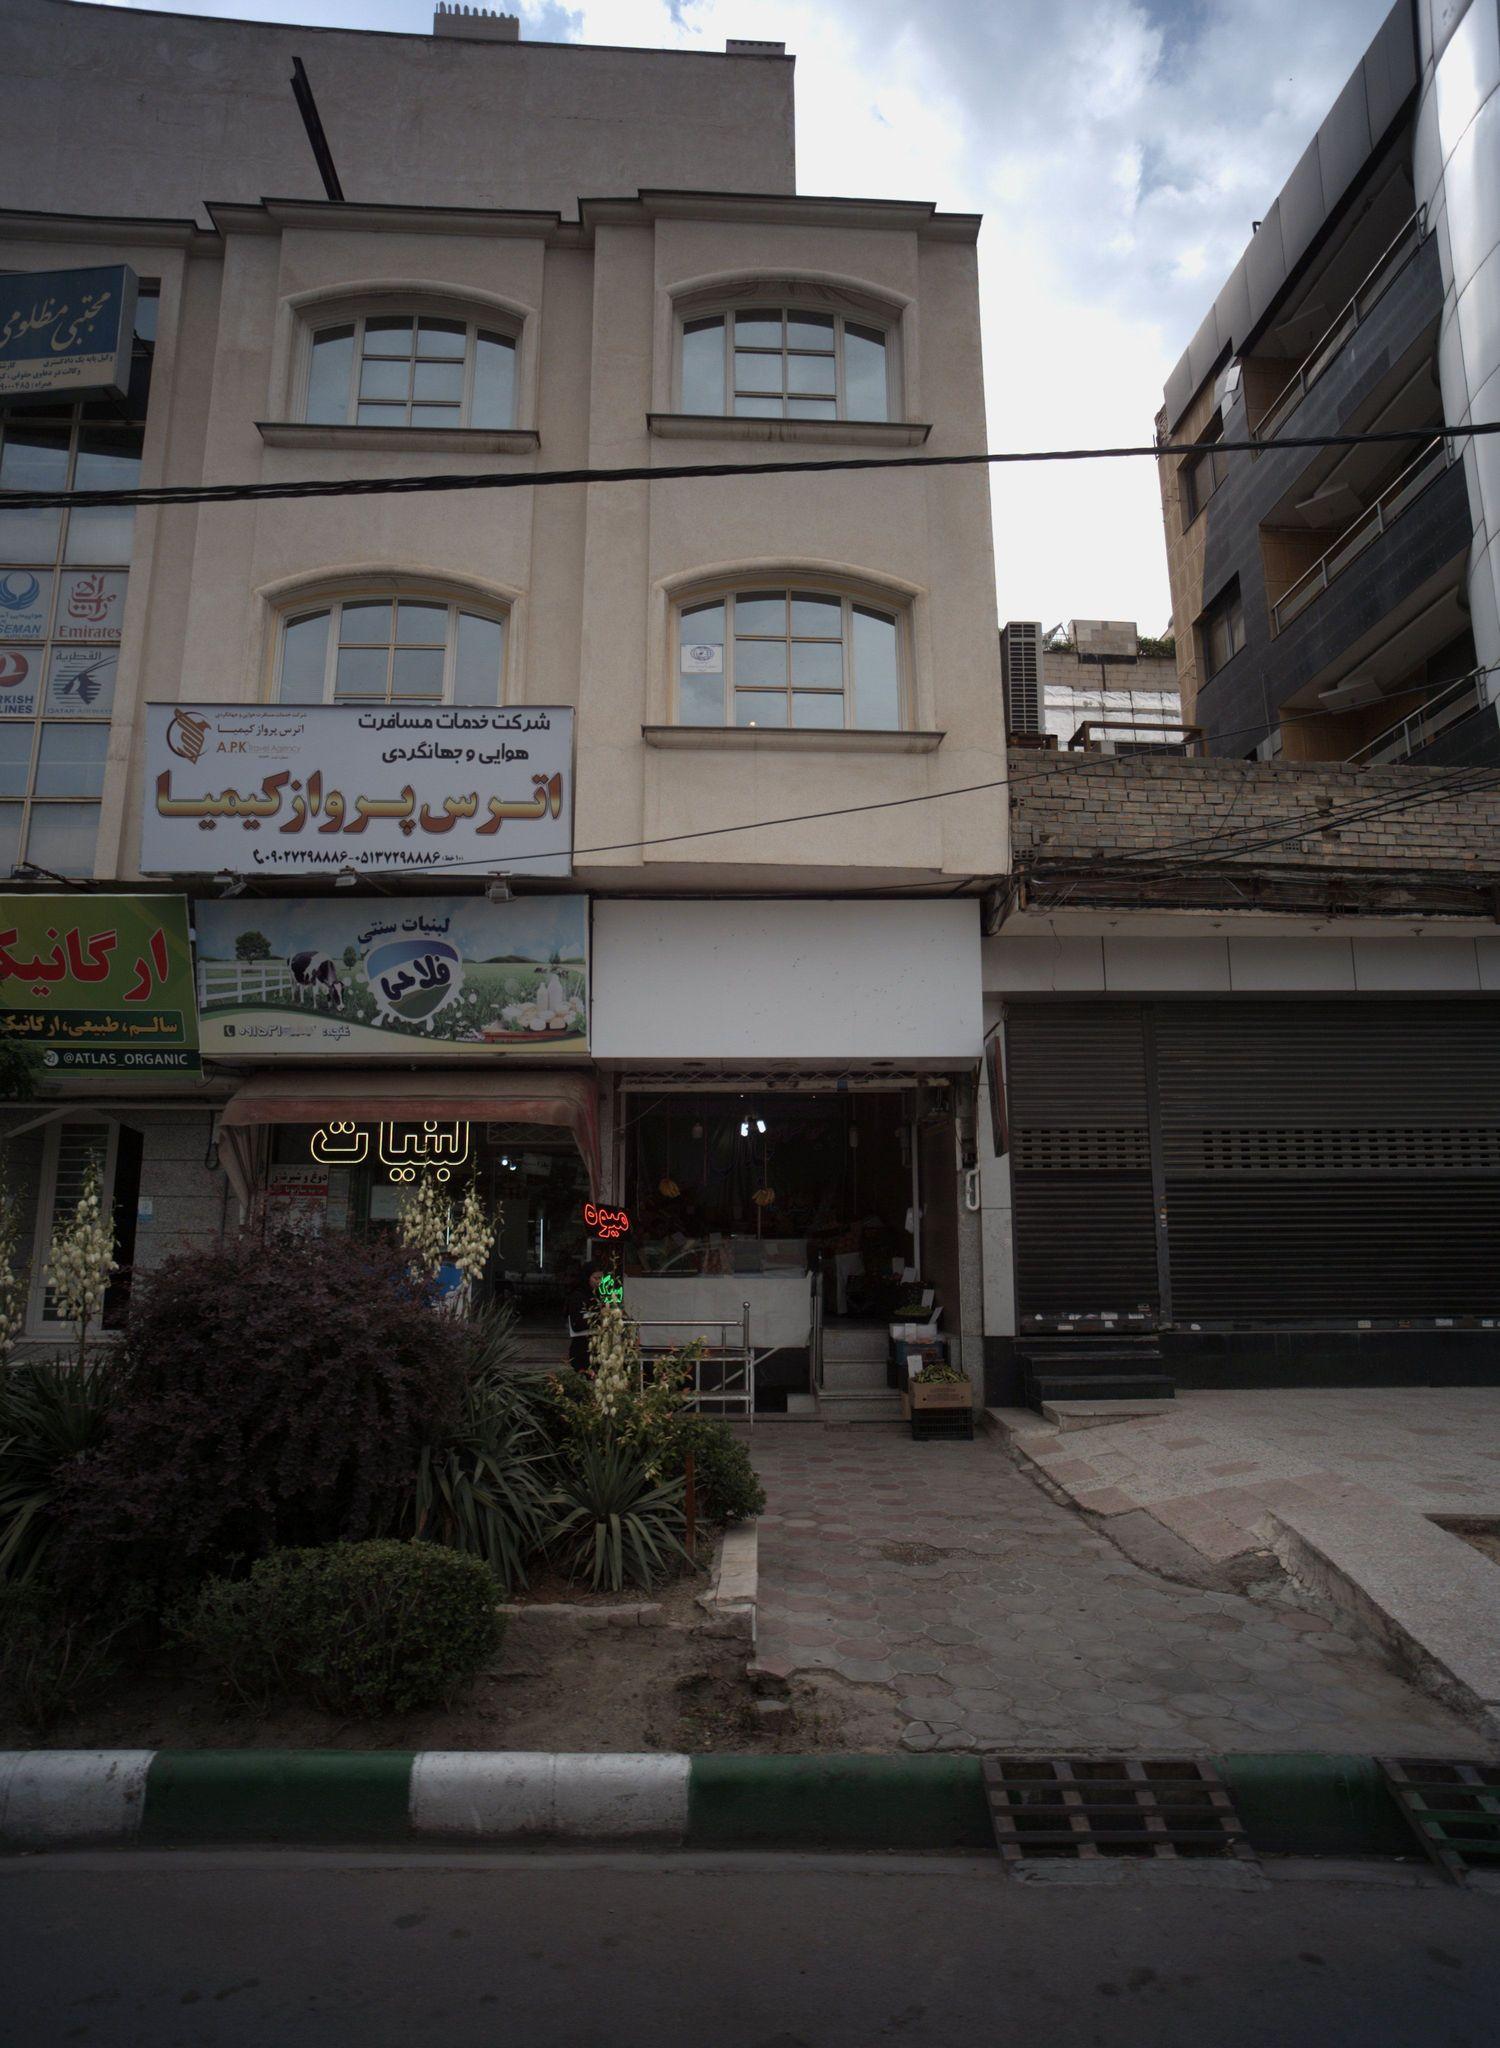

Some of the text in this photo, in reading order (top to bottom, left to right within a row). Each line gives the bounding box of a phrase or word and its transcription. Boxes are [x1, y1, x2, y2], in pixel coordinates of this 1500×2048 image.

[51, 292, 111, 351] مجتبی
[59, 625, 122, 638] Emirates
[217, 724, 255, 735] کیمیا
[256, 724, 277, 737] پرواز
[358, 712, 550, 732] شرکت خدمات مسافرت
[382, 741, 529, 765] هوایی و جهانگردی
[156, 769, 290, 831] کیمیا
[279, 770, 416, 836] پرواز
[357, 915, 450, 944] لبنیات سنتی
[381, 955, 451, 1000] فلاحی
[64, 1052, 188, 1066] @ATLAS_ORGANIC
[311, 1121, 469, 1182] لبنیات
